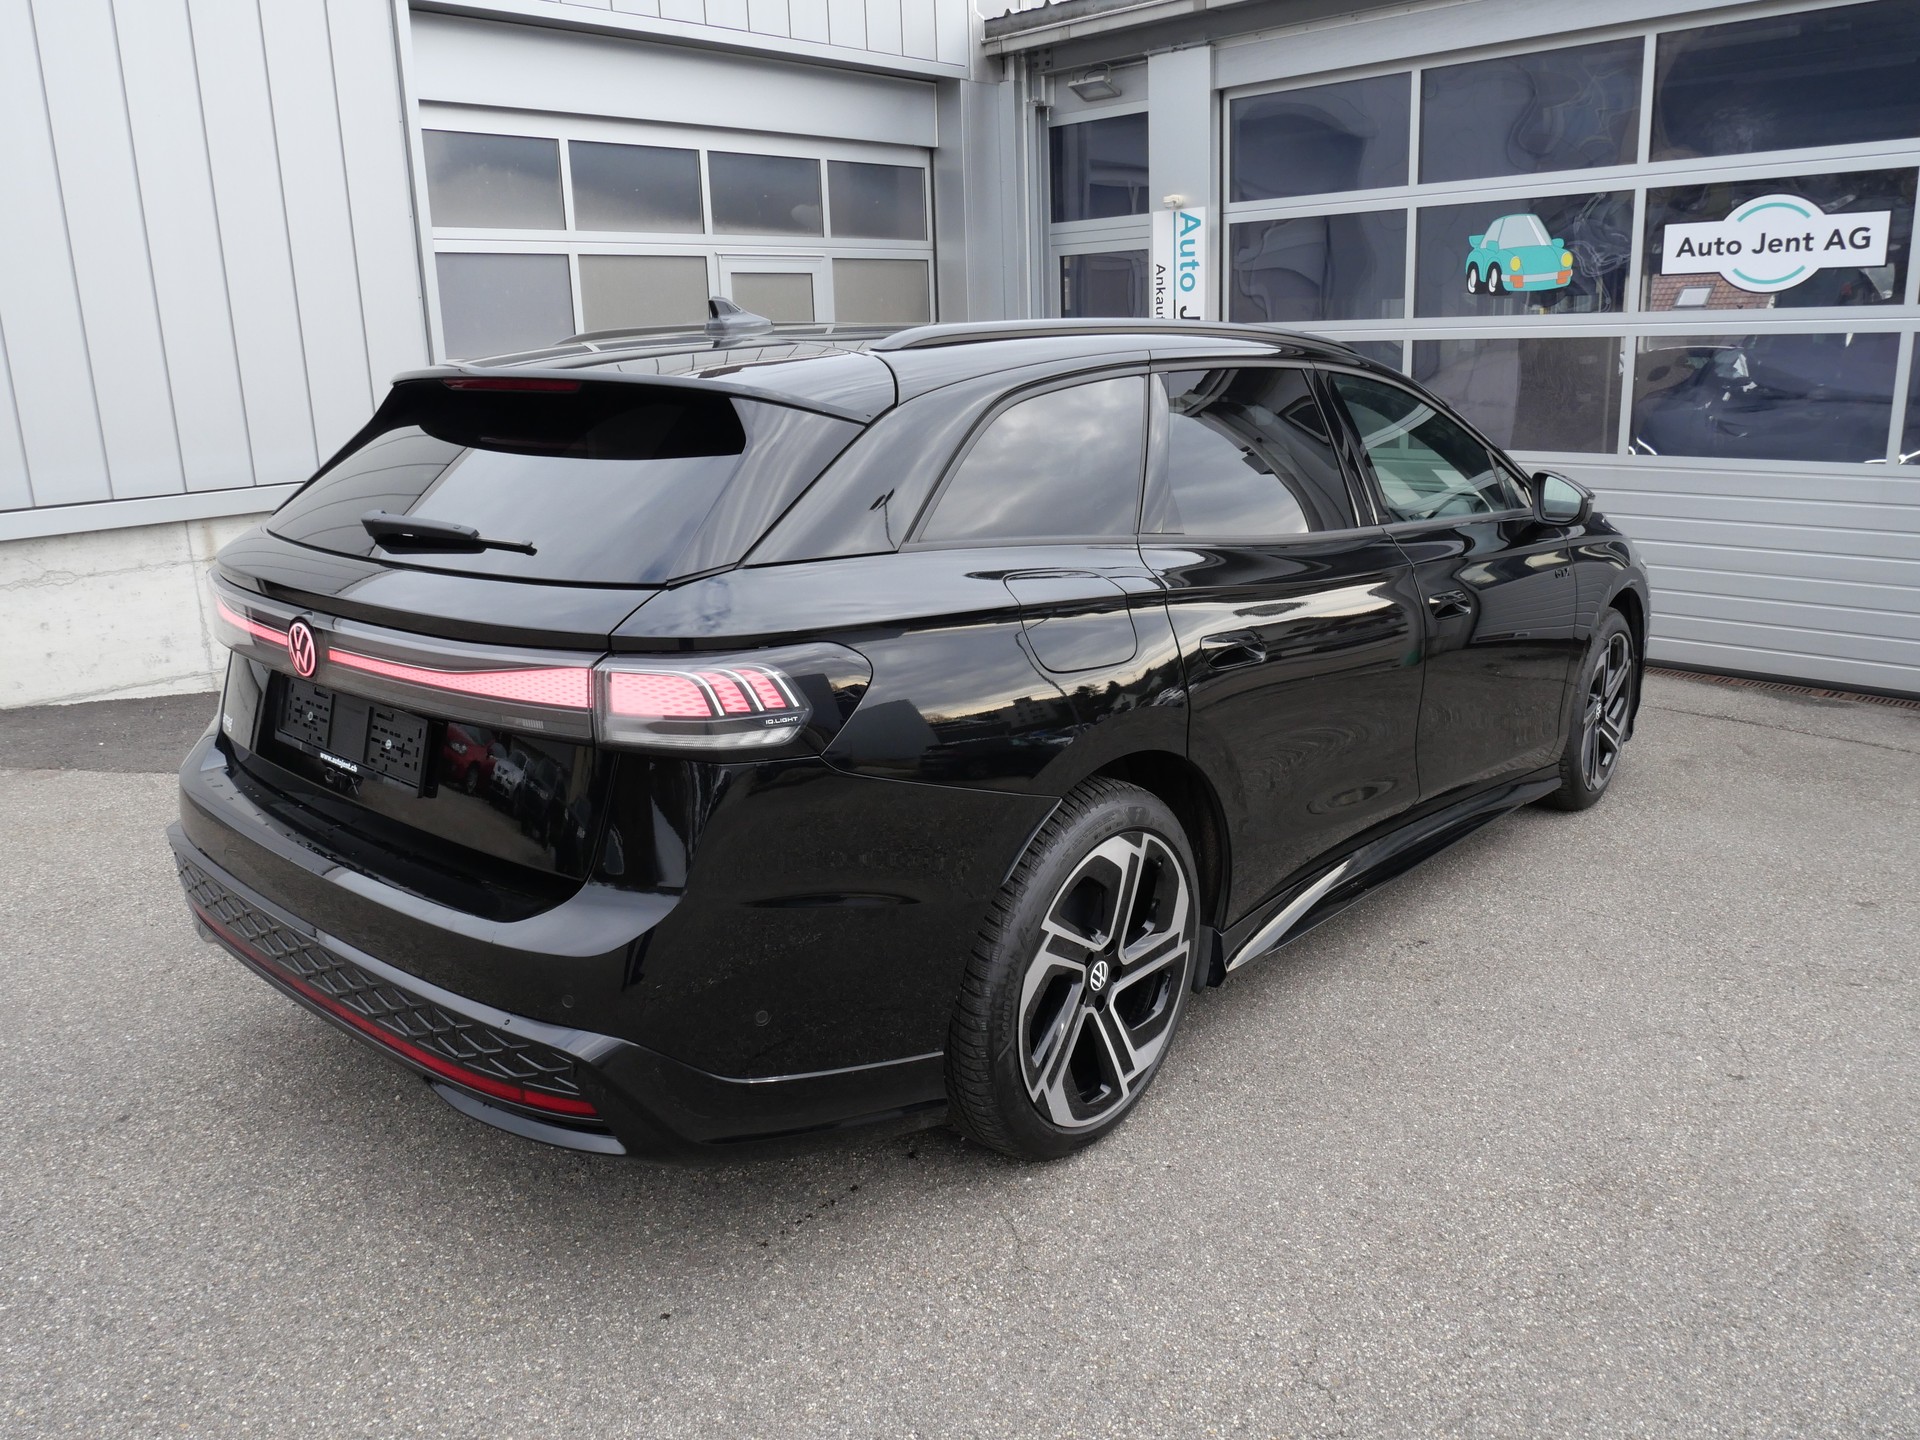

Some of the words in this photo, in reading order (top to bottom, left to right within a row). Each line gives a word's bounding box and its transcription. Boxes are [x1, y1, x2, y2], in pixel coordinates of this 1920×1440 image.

[1180, 211, 1201, 292] Auto
[1675, 236, 1742, 258] Auto
[1751, 232, 1815, 255] Jent
[1823, 226, 1872, 251] AG
[1155, 263, 1166, 319] Ankau
